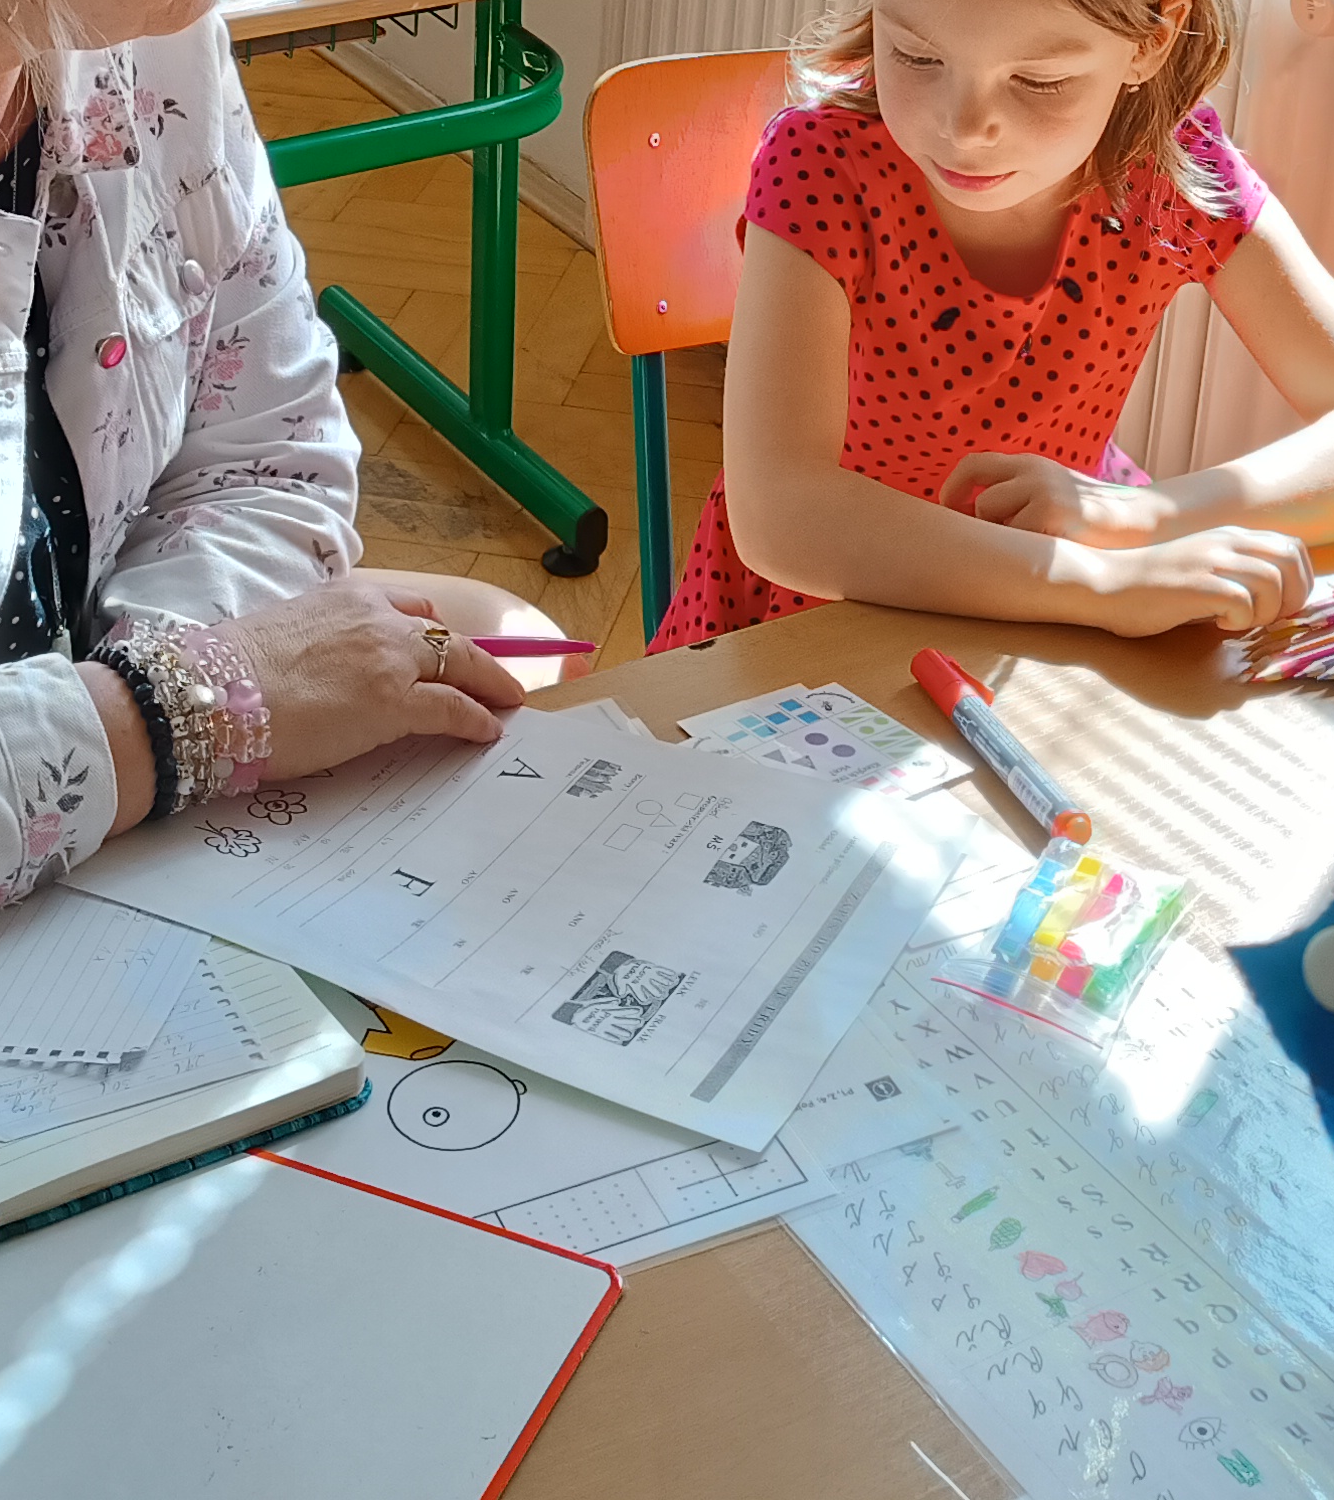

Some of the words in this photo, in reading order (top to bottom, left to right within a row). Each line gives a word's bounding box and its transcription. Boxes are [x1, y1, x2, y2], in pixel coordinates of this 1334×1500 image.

[496, 757, 545, 782] A
[704, 832, 726, 854] MŠ
[389, 862, 439, 900] F
[458, 866, 478, 888] ANO
[499, 884, 520, 907] ANO
[565, 908, 586, 931] ANO
[674, 967, 702, 1002] LEVÁK
[635, 1008, 667, 1048] PRAVÁK
[991, 1094, 1018, 1121] U
[1050, 1150, 1078, 1177] T
[1139, 1239, 1171, 1269] Ř
[1172, 1268, 1203, 1298] R
[1204, 1295, 1238, 1327] Q
